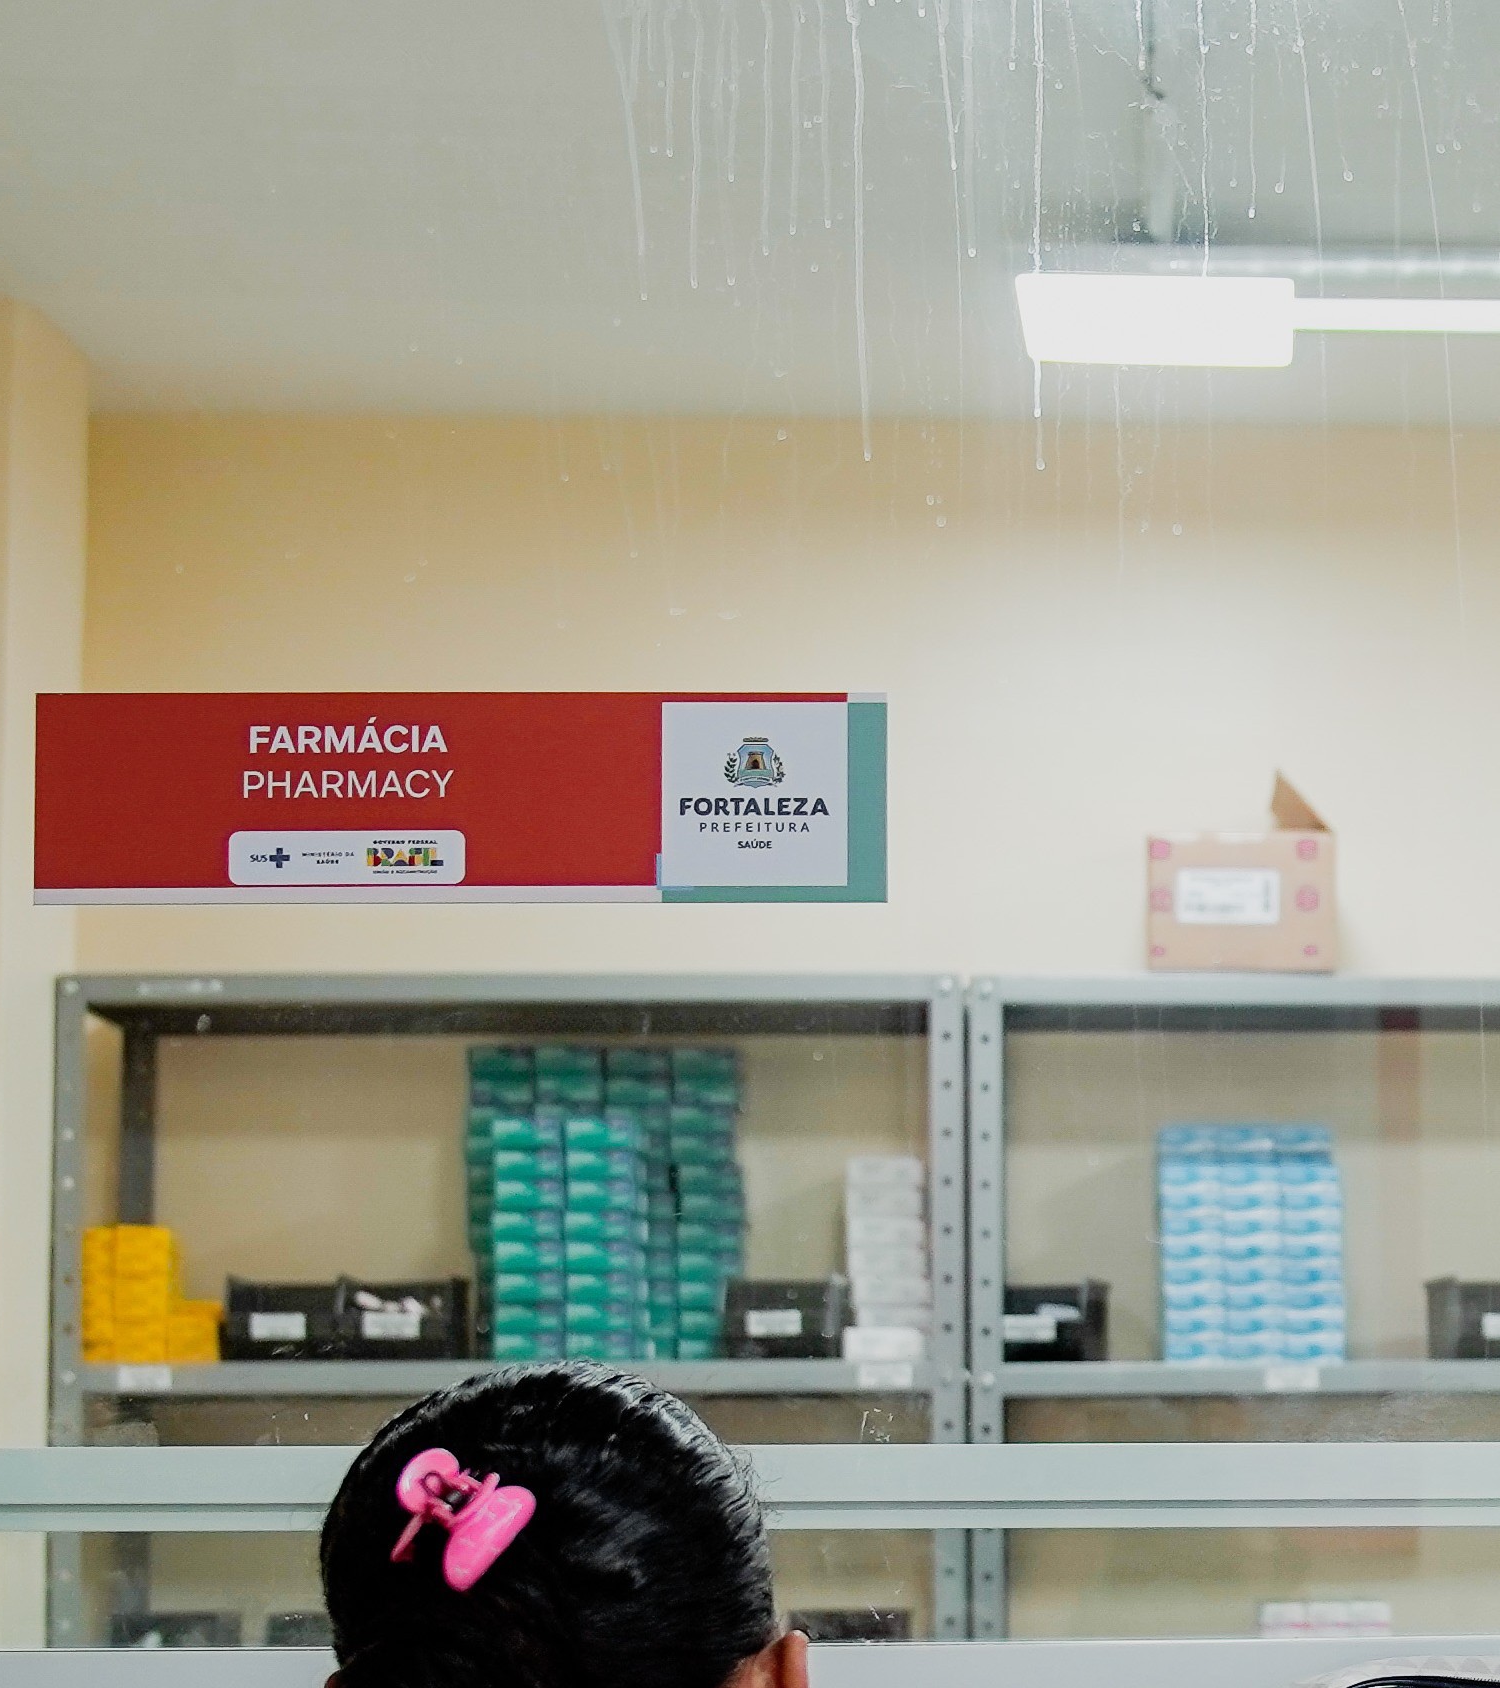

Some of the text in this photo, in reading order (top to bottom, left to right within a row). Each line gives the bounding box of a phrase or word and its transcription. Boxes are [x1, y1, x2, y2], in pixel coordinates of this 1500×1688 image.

[249, 716, 448, 753] FARMÁCIA
[243, 769, 454, 799] PHARMACY
[679, 797, 830, 816] FORTALEZA
[699, 822, 810, 833] PREFEITURA
[737, 838, 773, 849] SAÚDE
[249, 854, 268, 863] SUS
[366, 847, 444, 867] BRASIL
